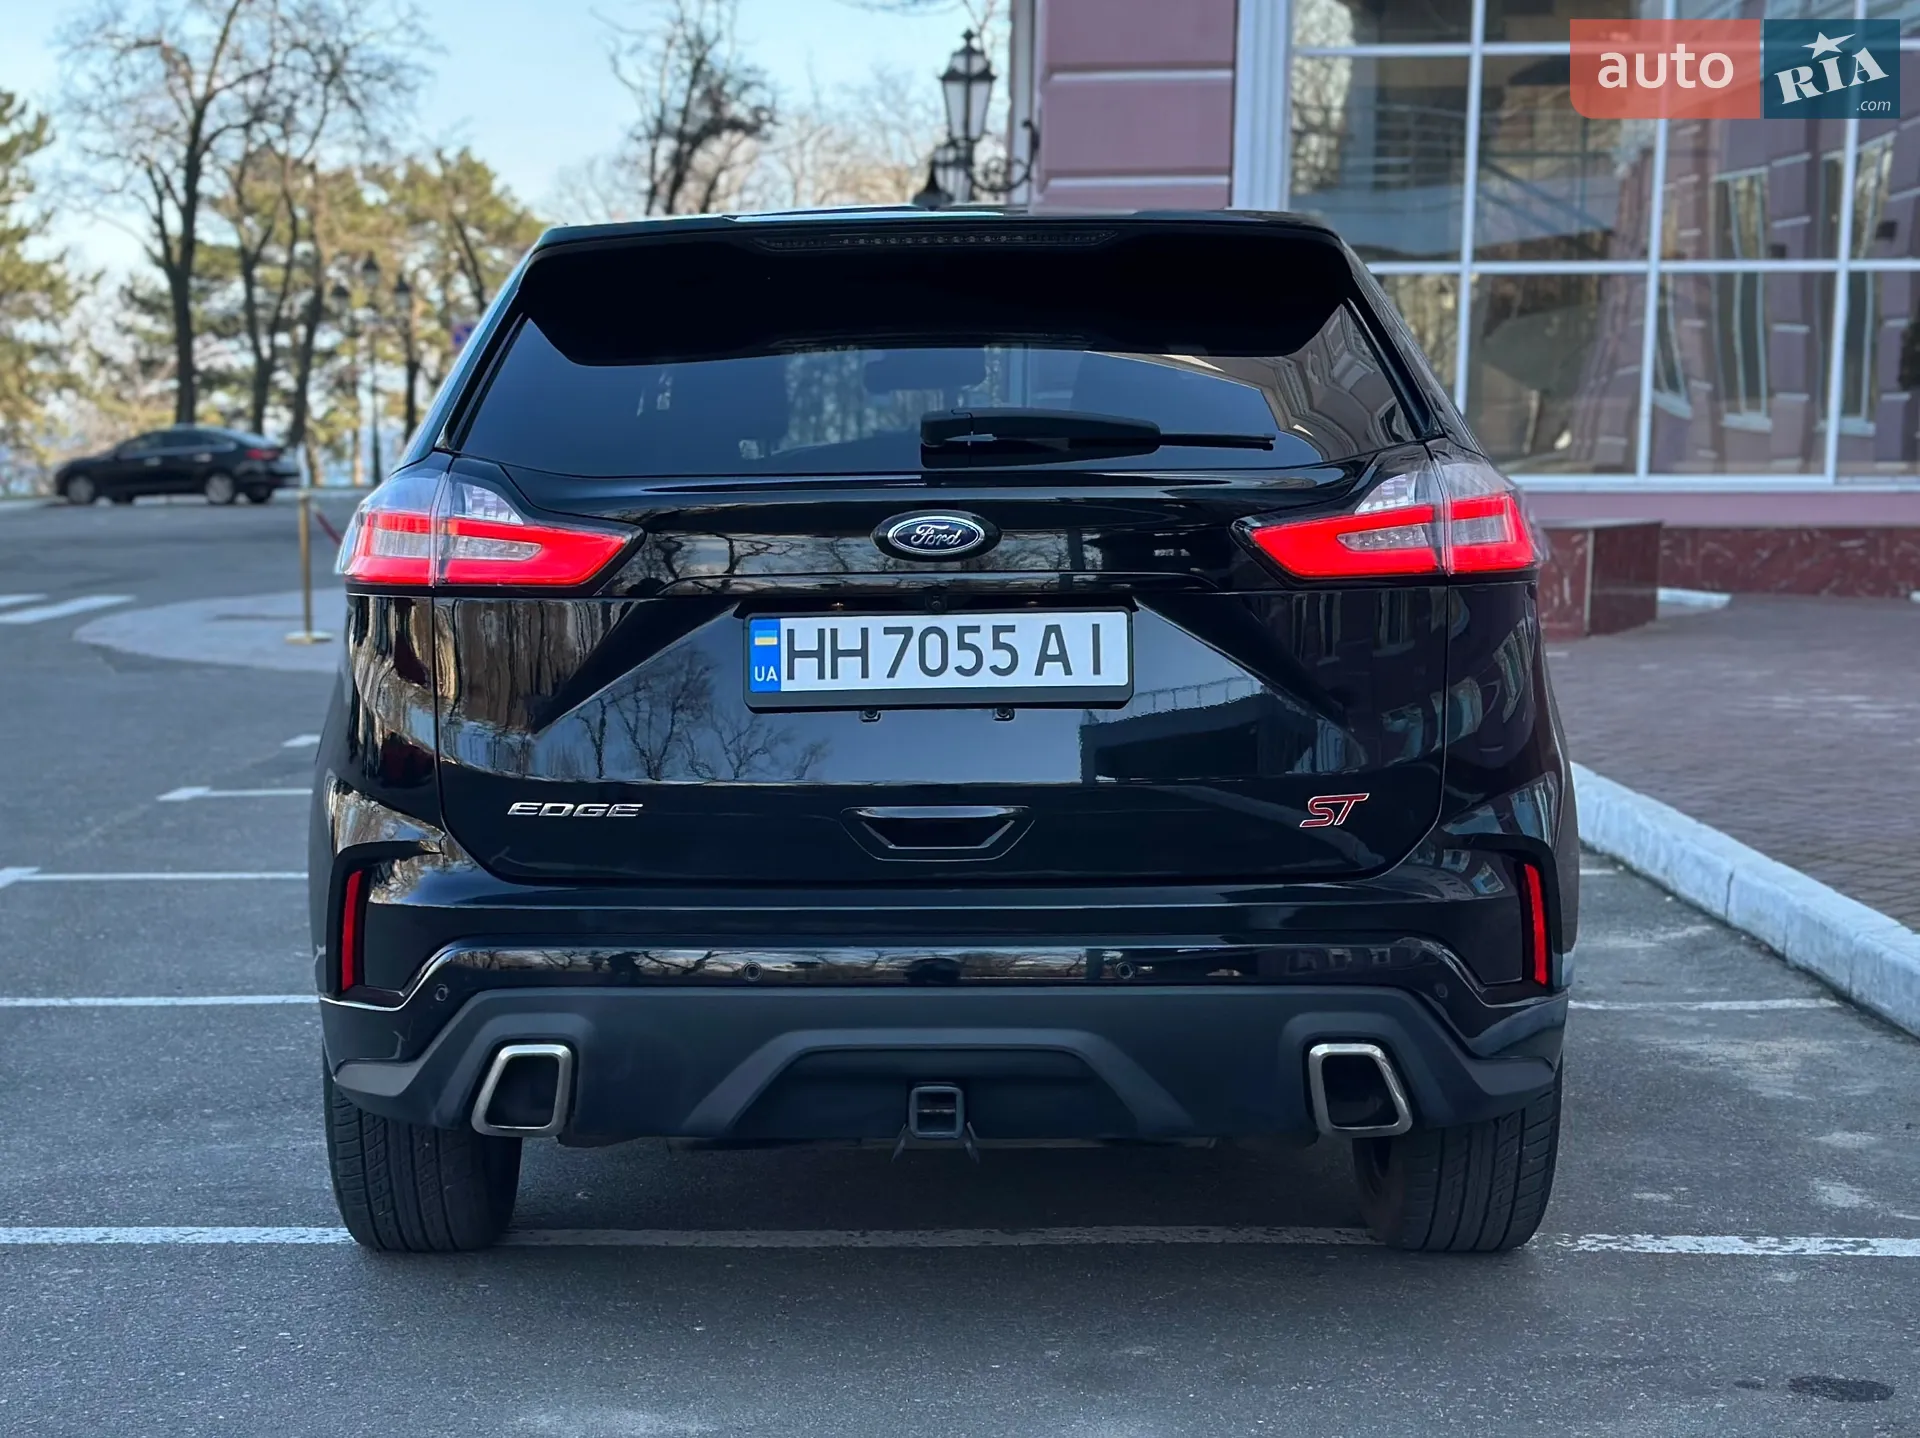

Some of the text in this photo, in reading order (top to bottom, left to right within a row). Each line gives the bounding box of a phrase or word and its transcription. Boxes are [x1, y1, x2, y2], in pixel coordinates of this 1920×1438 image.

[911, 524, 963, 546] Ford
[754, 666, 778, 682] UA
[507, 802, 644, 818] EDGE
[1299, 793, 1370, 828] ST
